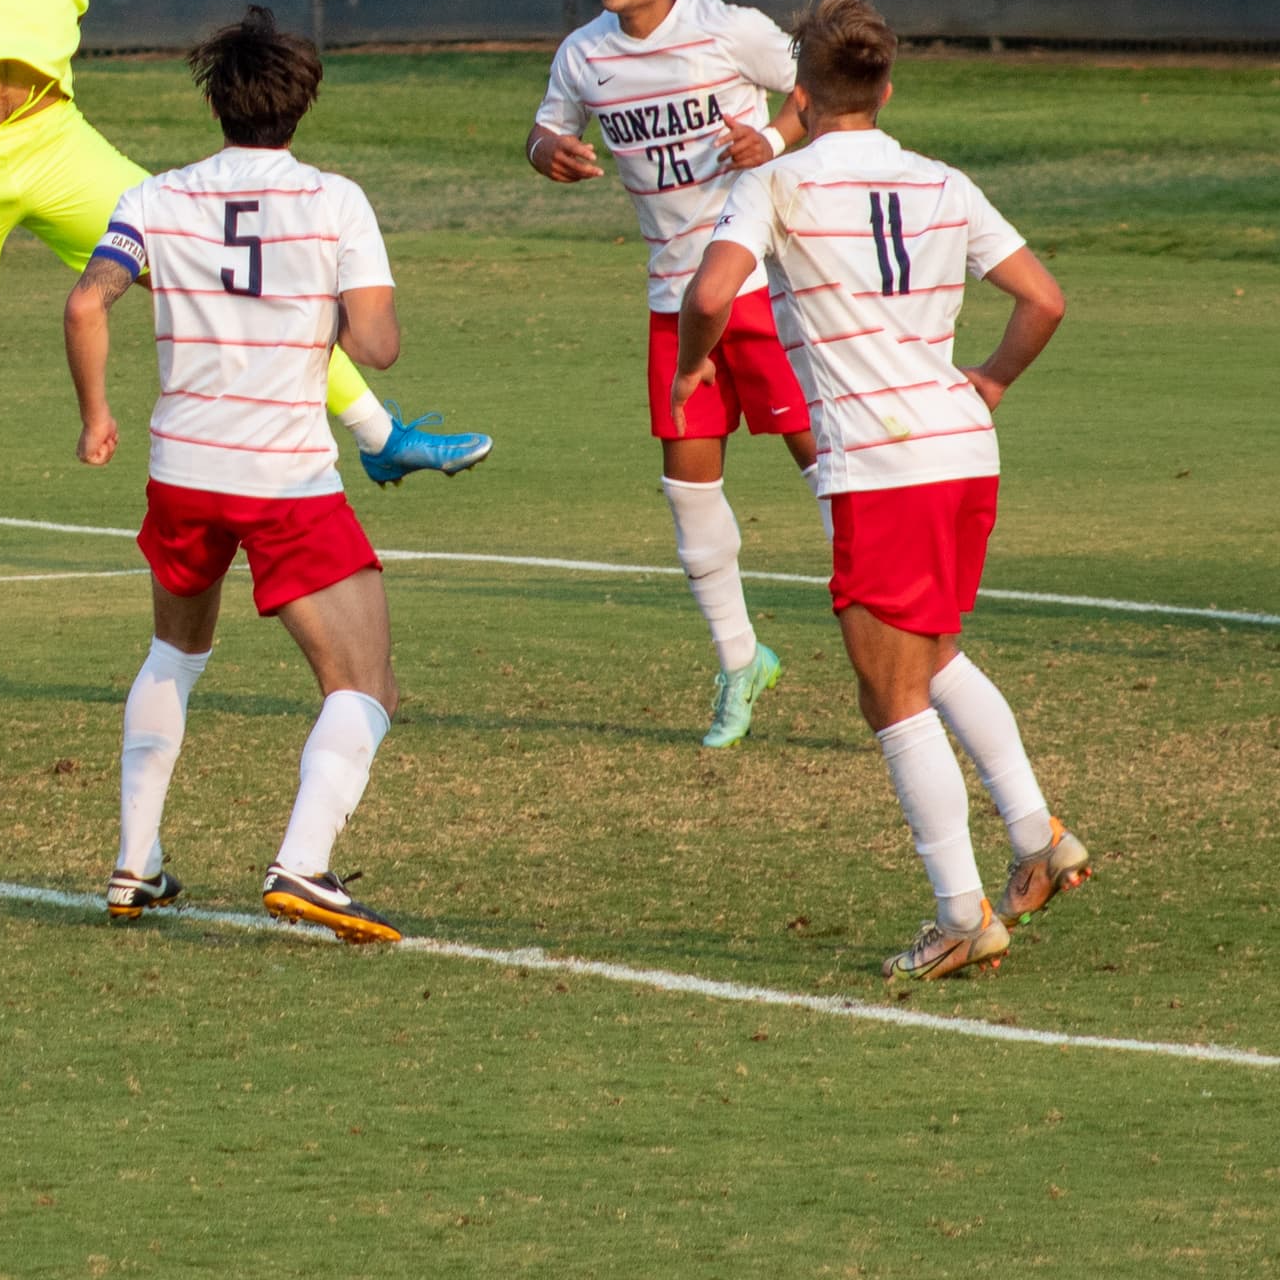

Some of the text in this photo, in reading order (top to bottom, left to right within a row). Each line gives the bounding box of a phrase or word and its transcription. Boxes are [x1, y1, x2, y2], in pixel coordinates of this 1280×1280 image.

[598, 93, 724, 144] GONZAGA
[645, 142, 695, 191] 26
[221, 200, 263, 298] 5
[870, 192, 911, 297] 11
[107, 886, 137, 905] NIKE
